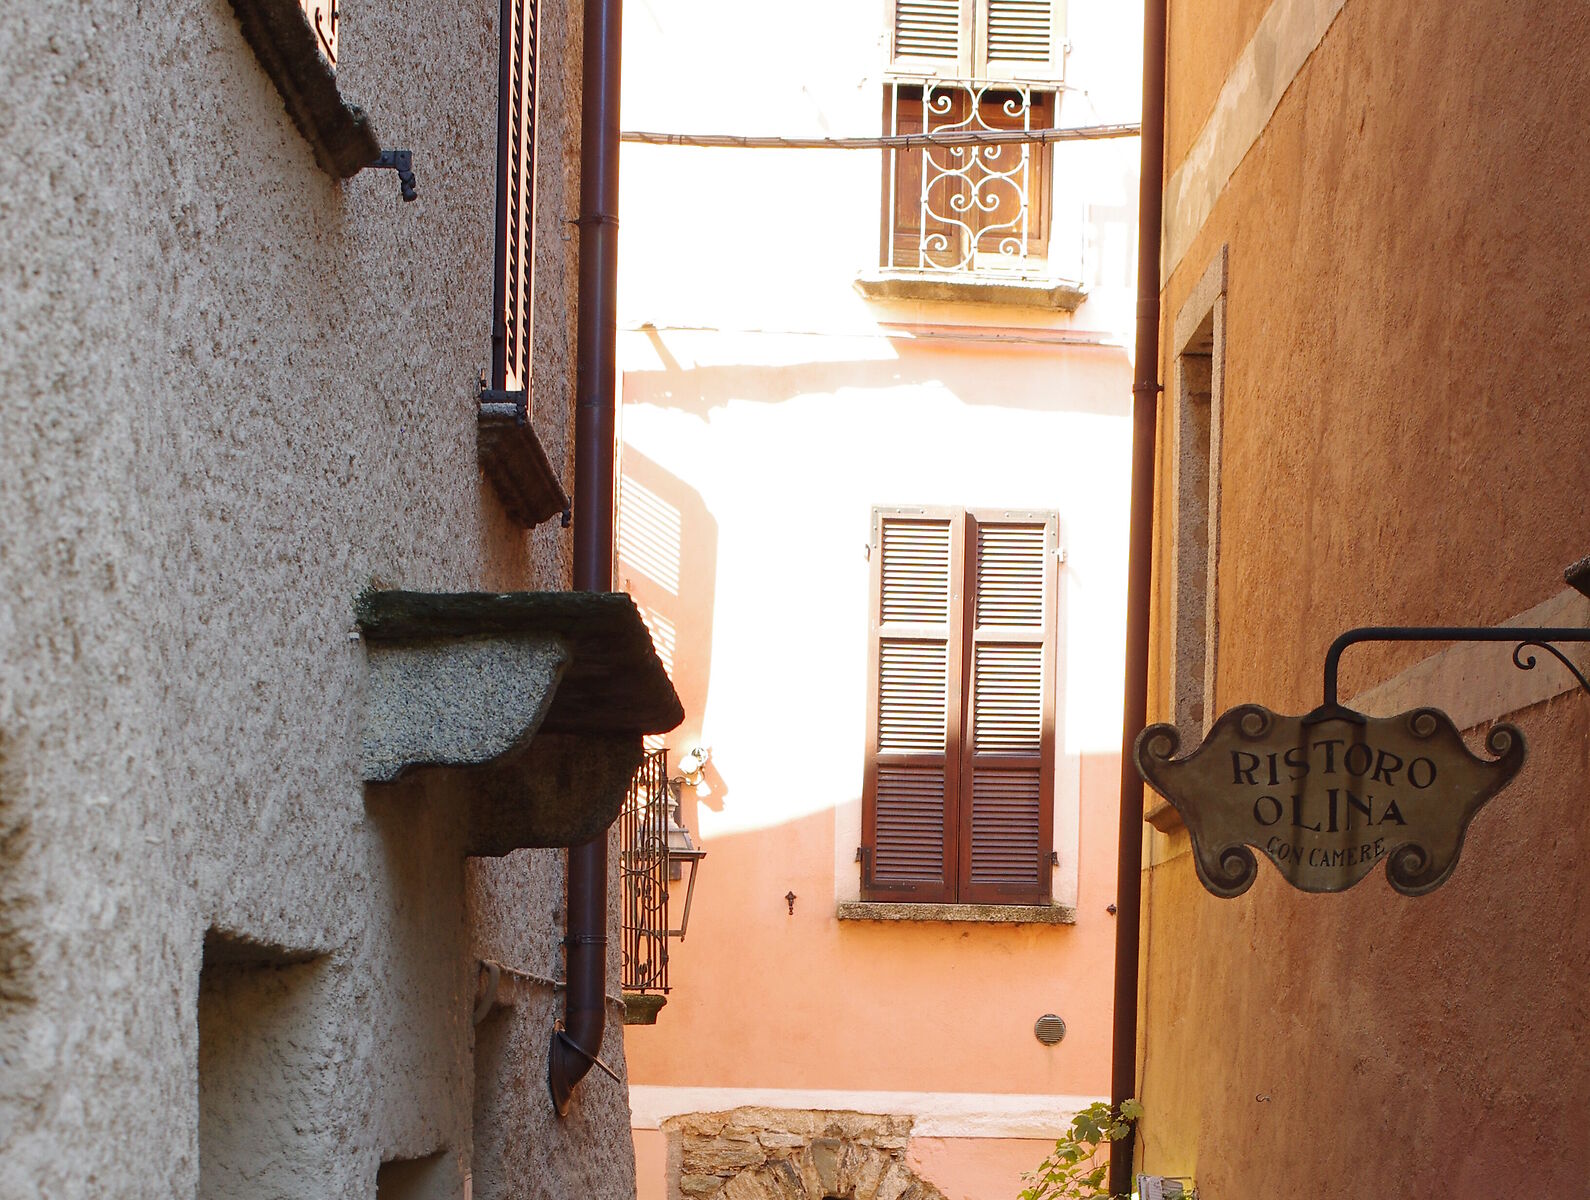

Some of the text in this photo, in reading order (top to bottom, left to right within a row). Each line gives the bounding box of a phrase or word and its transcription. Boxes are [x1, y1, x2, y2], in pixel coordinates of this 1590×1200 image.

[1231, 738, 1437, 789] RISTORO
[1253, 788, 1408, 833] OLINA
[1266, 835, 1385, 867] CON CAMERE
